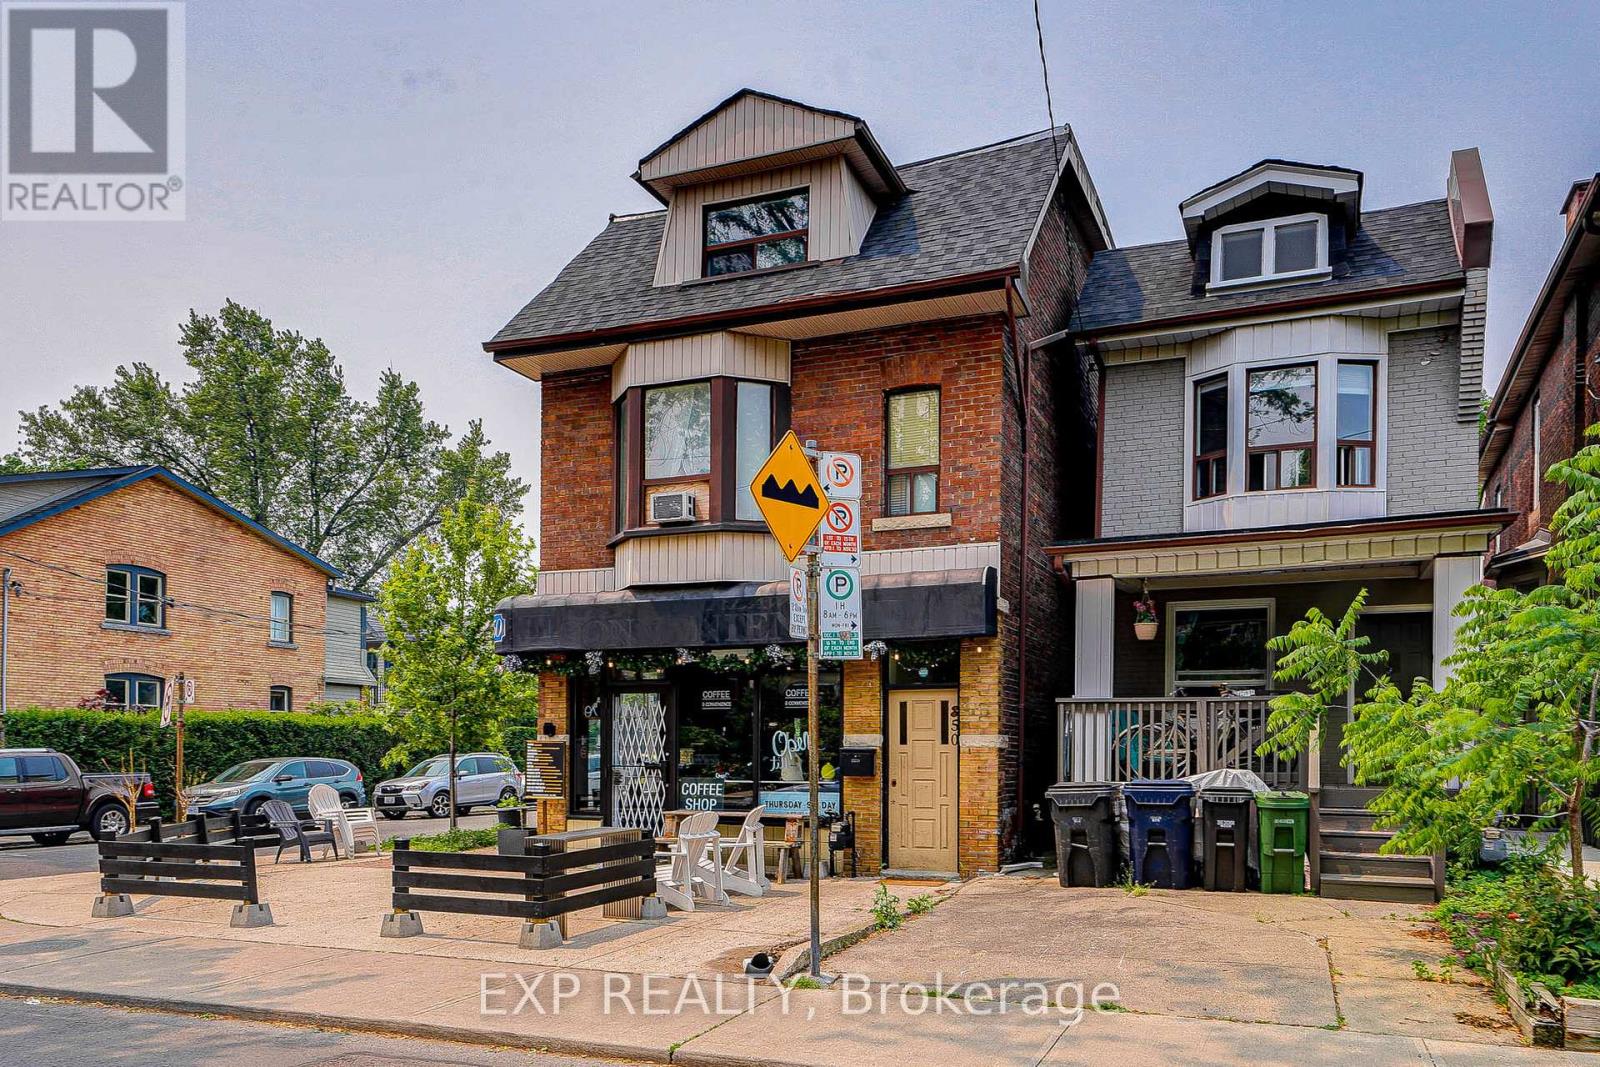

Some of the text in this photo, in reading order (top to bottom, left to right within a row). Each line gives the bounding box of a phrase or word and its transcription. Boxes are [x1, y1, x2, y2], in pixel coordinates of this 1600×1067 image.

[702, 690, 731, 699] COFFEE
[785, 689, 809, 697] COFFE
[681, 782, 723, 796] COFFEE
[685, 798, 717, 811] SHOP
[765, 800, 803, 809] THURSDAY
[807, 801, 836, 809] SDAY
